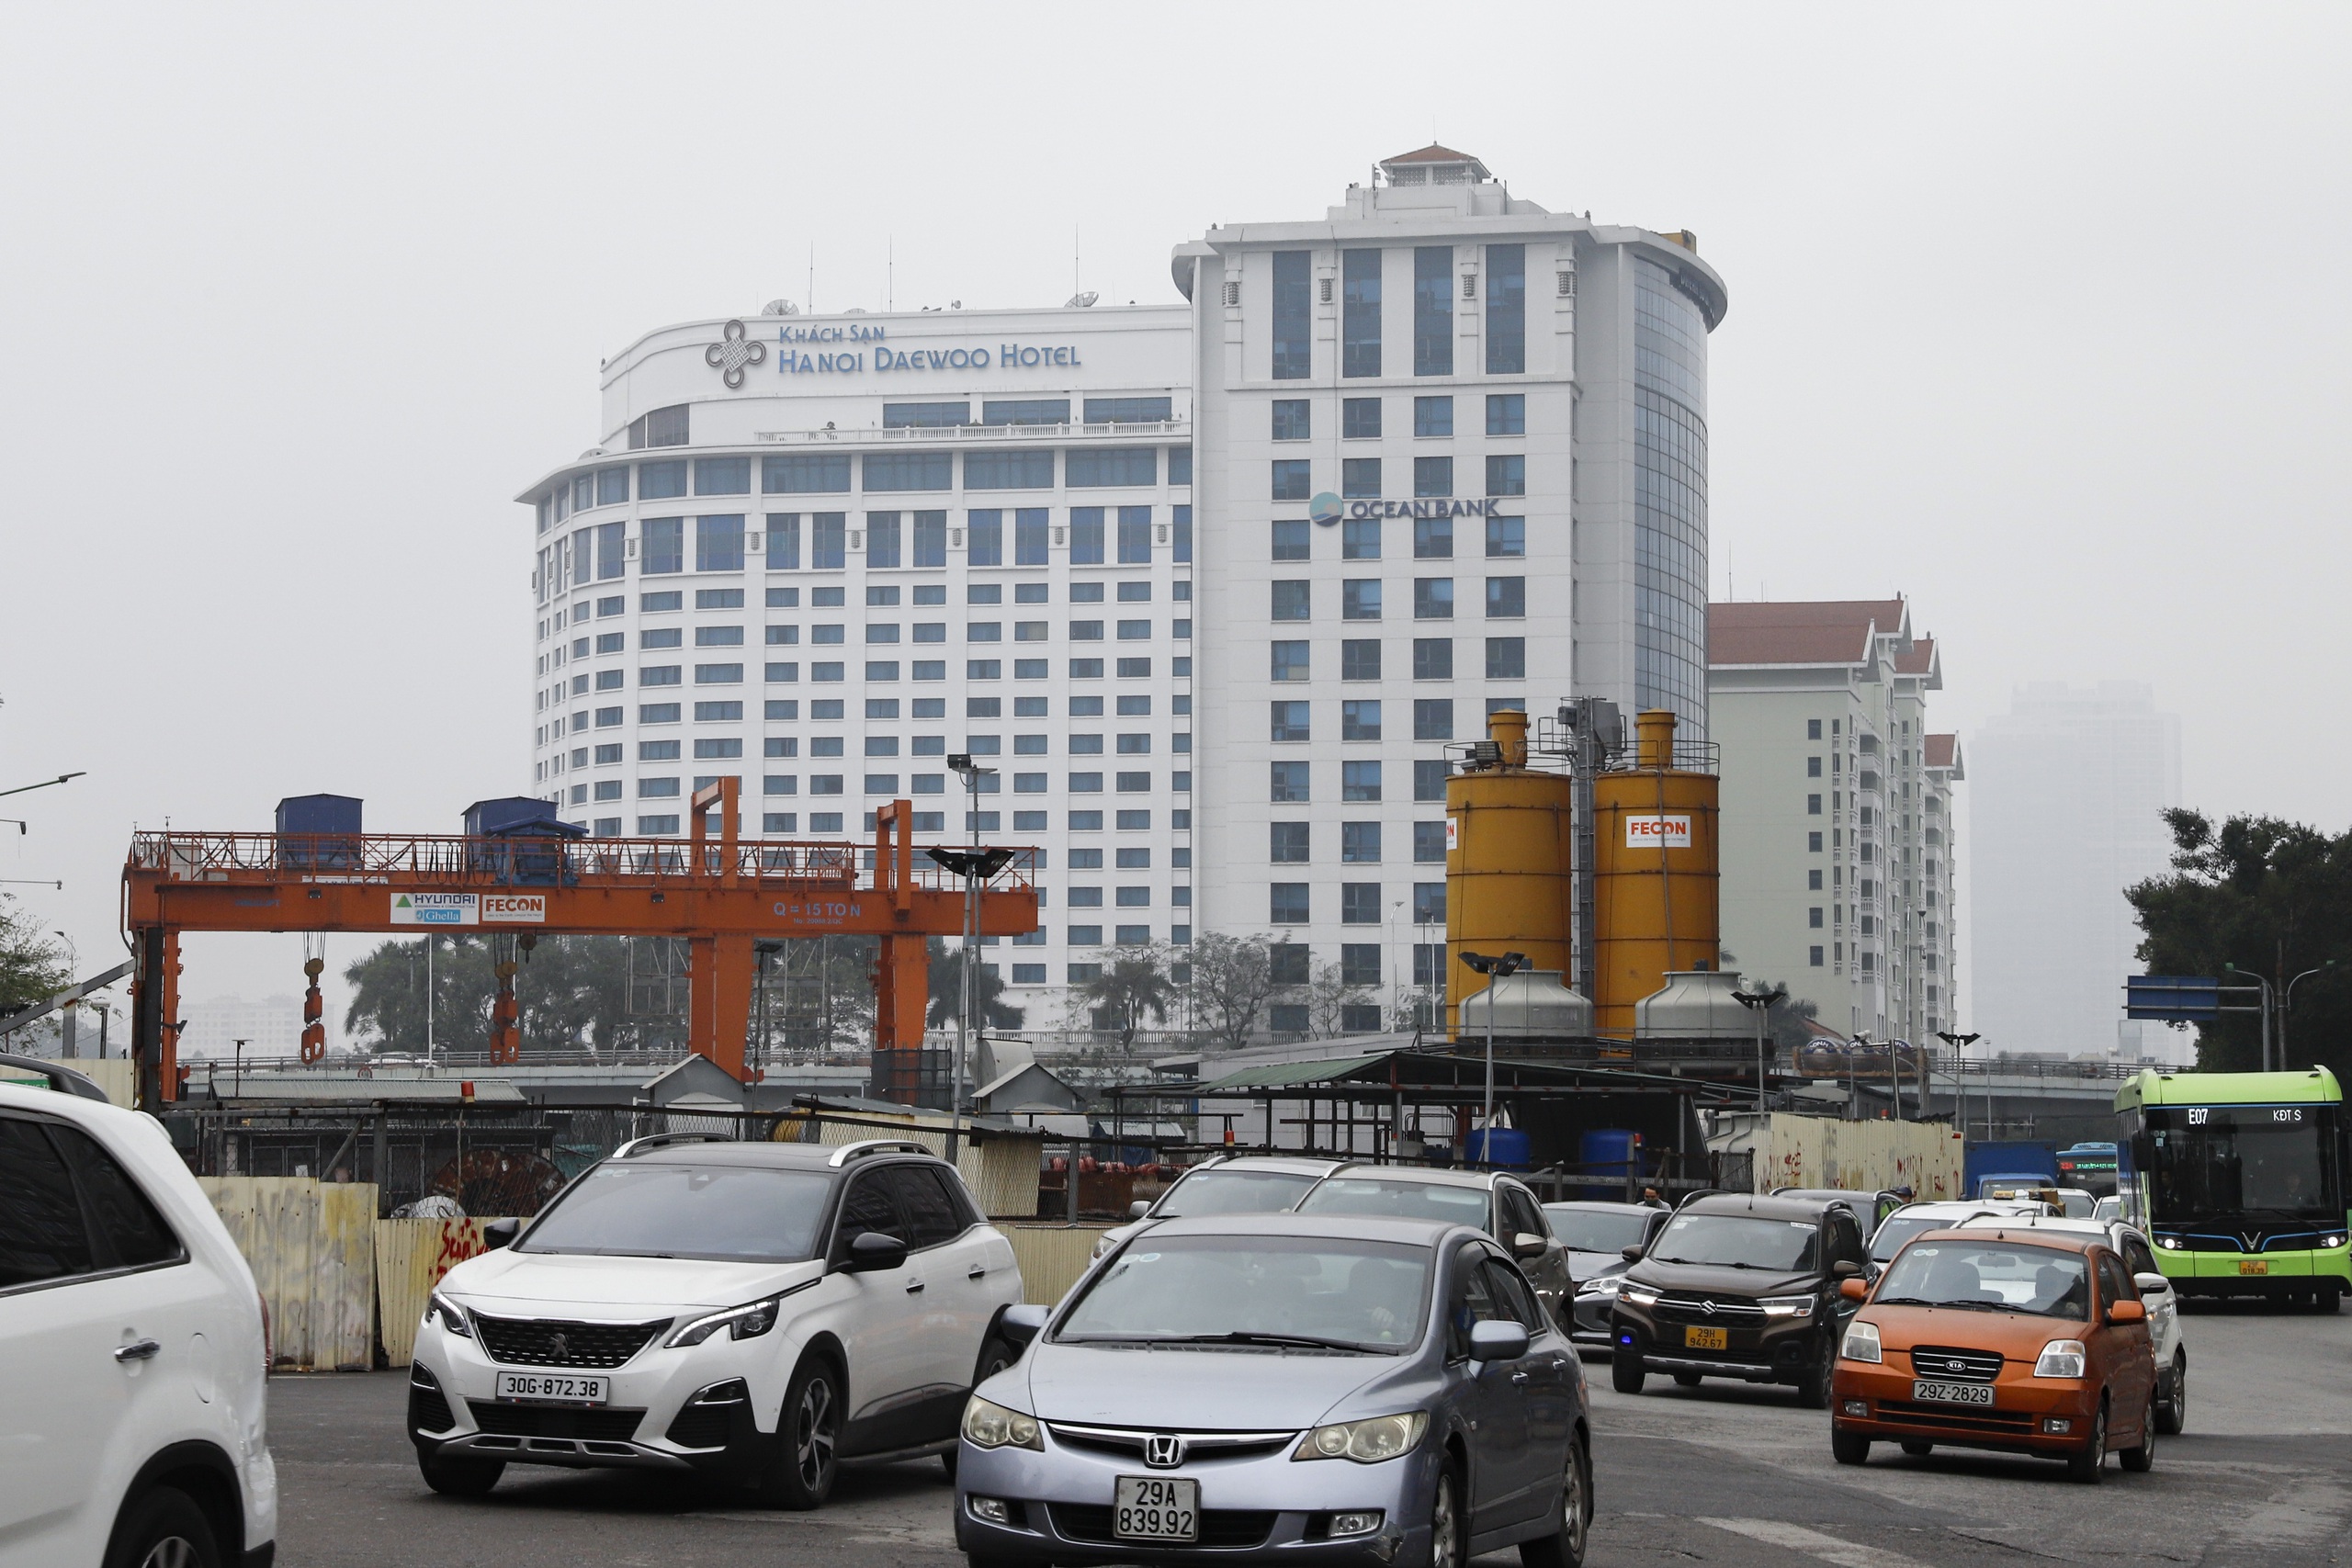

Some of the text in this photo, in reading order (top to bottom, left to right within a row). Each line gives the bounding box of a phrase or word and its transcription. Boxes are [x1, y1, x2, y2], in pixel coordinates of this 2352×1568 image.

[779, 324, 885, 344] KHÁCH SẠN
[779, 344, 1081, 373] HANOI DAEWOO HOTEL
[1351, 499, 1501, 518] OCEAN BANK
[1631, 821, 1686, 835] FECON
[414, 895, 476, 905] HYUNDAI
[485, 898, 542, 912] FECON
[425, 910, 460, 921] Ghella
[774, 902, 786, 917] Q
[805, 903, 821, 916] 15
[2188, 1108, 2208, 1125] E07
[2273, 1109, 2302, 1122] KĐT S
[1697, 1328, 1715, 1338] 29H
[1690, 1337, 1723, 1348] 942.67
[506, 1377, 599, 1397] 30G-872.38
[1136, 1481, 1177, 1506] 29A
[1119, 1507, 1193, 1535] 839.92
